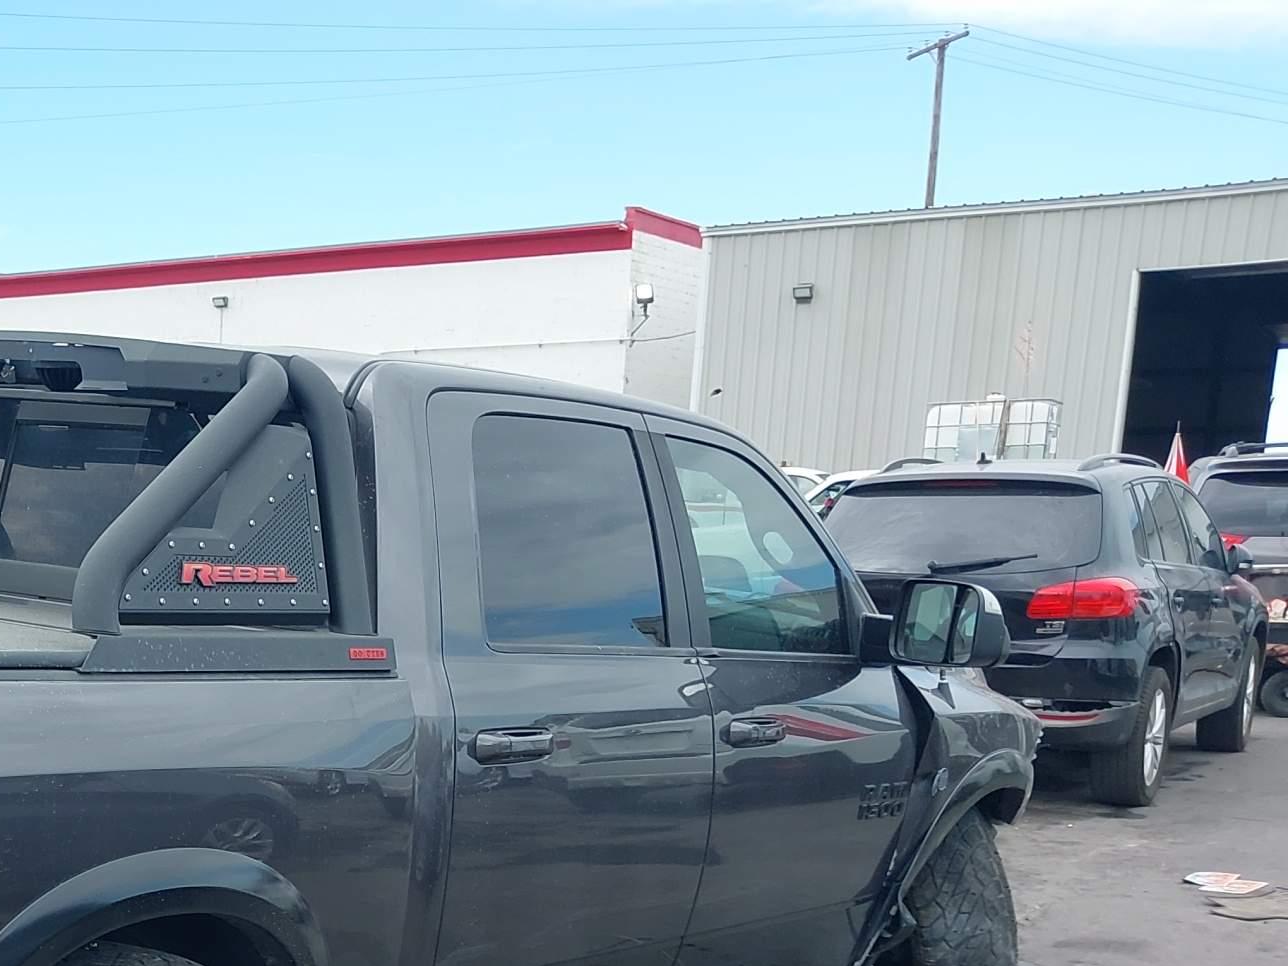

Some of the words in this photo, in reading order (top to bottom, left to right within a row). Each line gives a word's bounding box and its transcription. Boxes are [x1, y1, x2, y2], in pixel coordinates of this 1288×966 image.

[181, 562, 298, 587] REBEL
[860, 782, 909, 801] RAM
[857, 801, 905, 820] 1500
